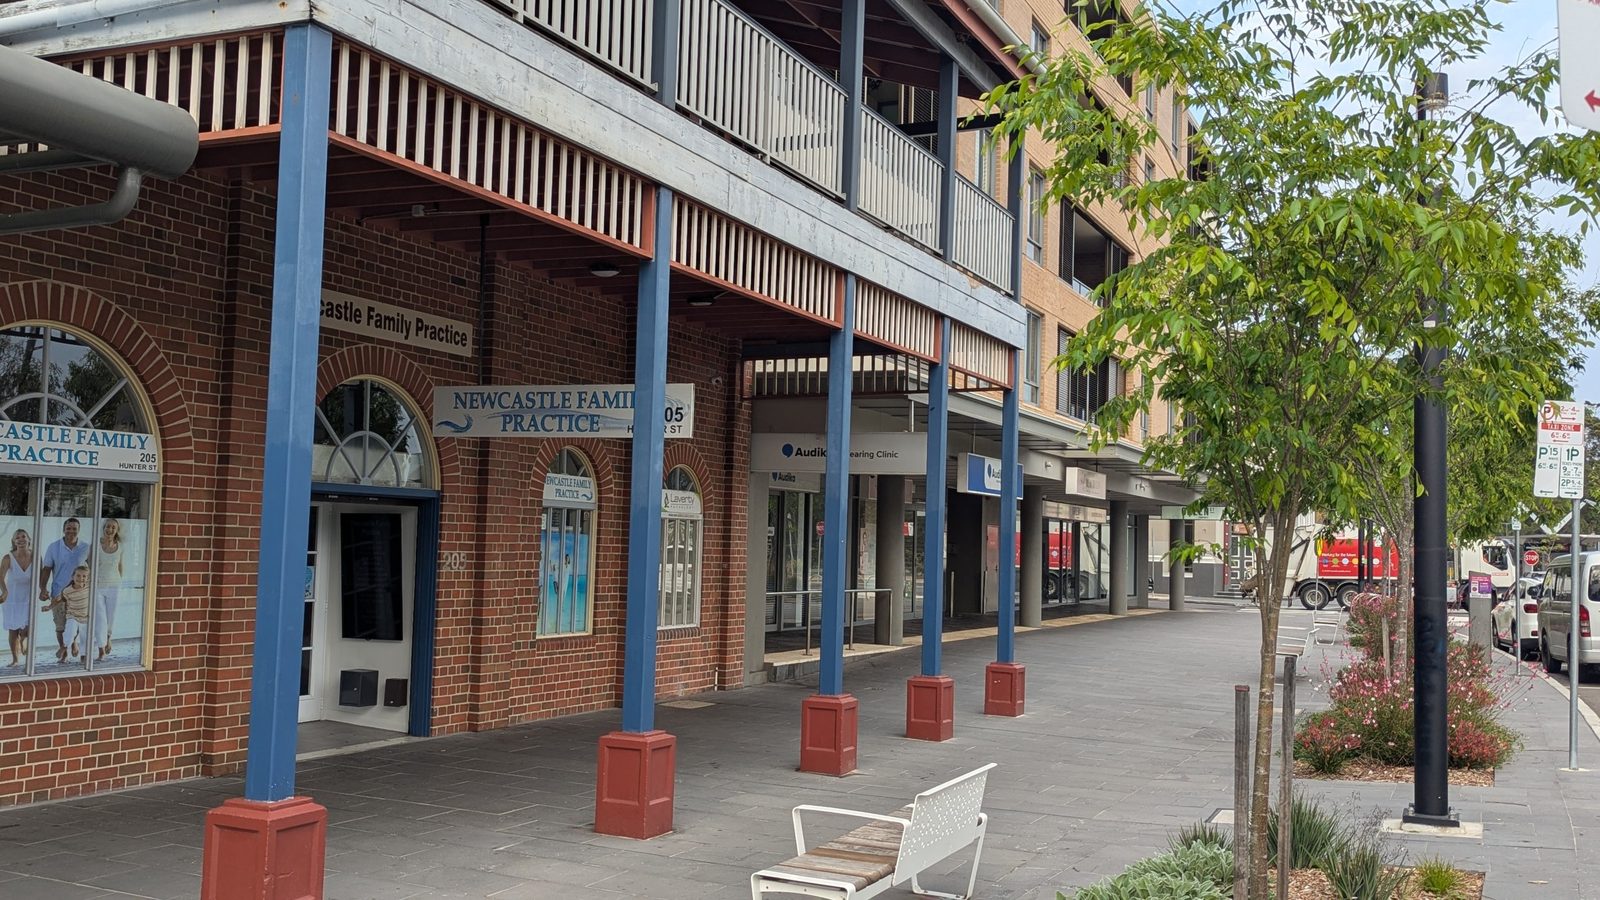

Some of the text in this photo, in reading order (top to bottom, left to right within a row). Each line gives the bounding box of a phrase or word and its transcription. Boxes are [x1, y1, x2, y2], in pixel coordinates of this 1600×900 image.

[366, 305, 412, 340] Family
[415, 317, 468, 347] Practice
[453, 391, 636, 410] NEWCASTLE FAMI
[665, 406, 684, 423] 05
[501, 414, 601, 433] PRACTICE
[670, 425, 683, 434] ST
[76, 429, 149, 451] FAMILY
[0, 443, 99, 466] PRACTICE
[140, 452, 157, 463] 205
[794, 447, 899, 460] Audik earing Clinic
[1566, 449, 1579, 461] 1P
[119, 462, 146, 470] HUNTER
[574, 479, 592, 489] FAMILY
[555, 489, 579, 499] PRACTICE
[443, 552, 467, 571] 205
[1525, 554, 1539, 562] STOP
